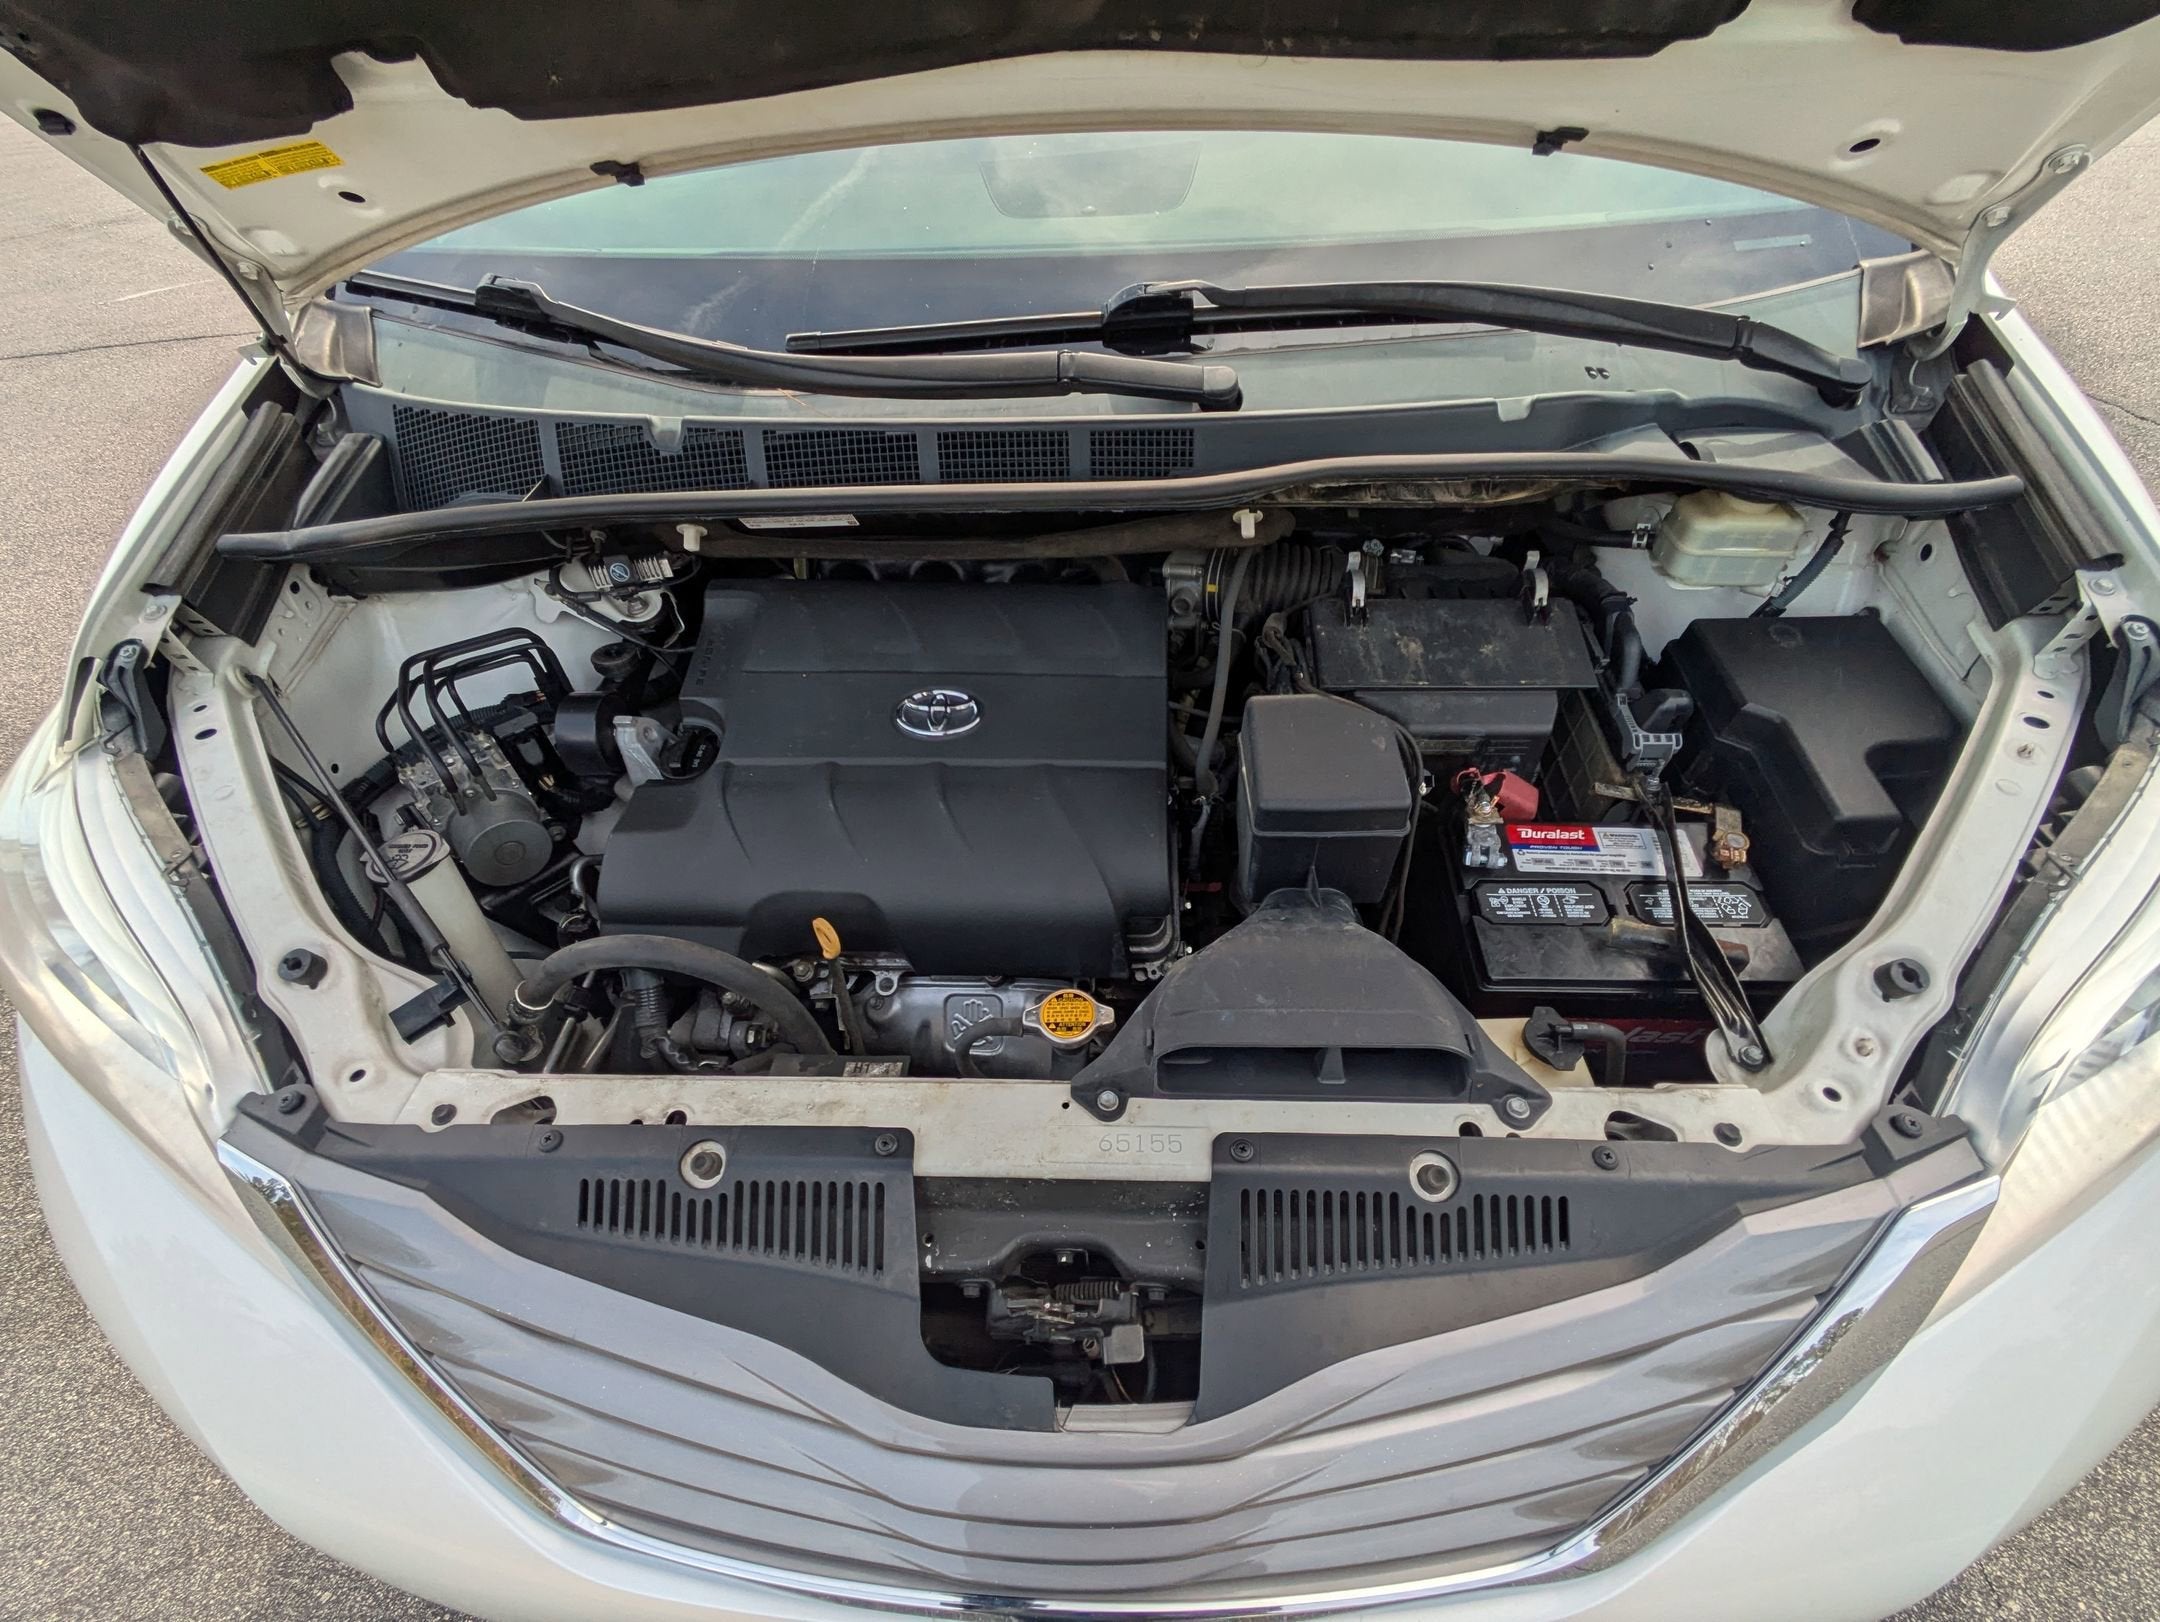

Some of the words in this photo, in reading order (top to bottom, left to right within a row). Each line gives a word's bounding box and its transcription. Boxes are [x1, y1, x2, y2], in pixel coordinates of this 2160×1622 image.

[1516, 828, 1585, 840] Duralast
[1624, 1026, 1706, 1044] last
[1098, 1133, 1183, 1154] 65155
